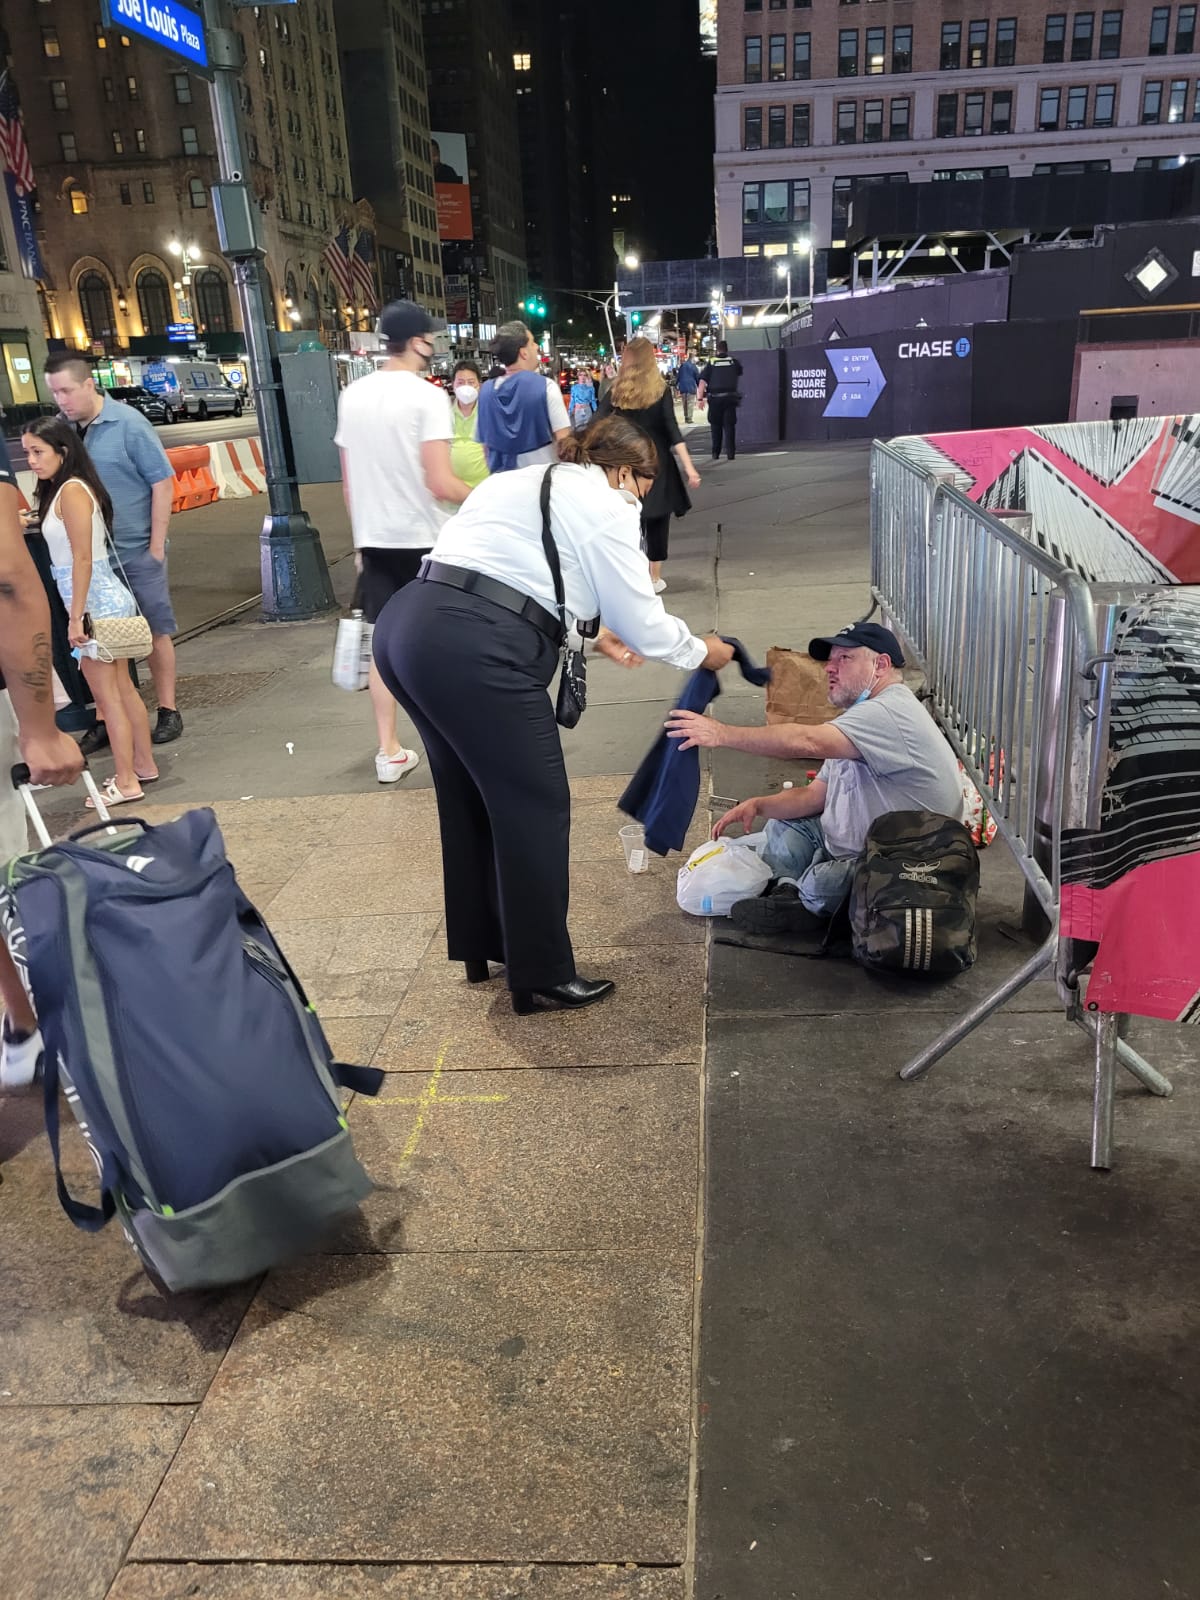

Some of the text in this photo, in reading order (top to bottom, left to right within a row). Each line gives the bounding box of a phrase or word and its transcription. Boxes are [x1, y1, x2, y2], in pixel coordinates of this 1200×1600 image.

[143, 0, 178, 42] Louis
[180, 24, 200, 51] Plaza
[18, 200, 31, 230] PNC
[898, 340, 953, 358] CHASE
[792, 369, 827, 378] MADISON
[792, 379, 826, 388] SQUARE
[792, 389, 826, 399] GARDEN
[899, 871, 938, 885] adidas
